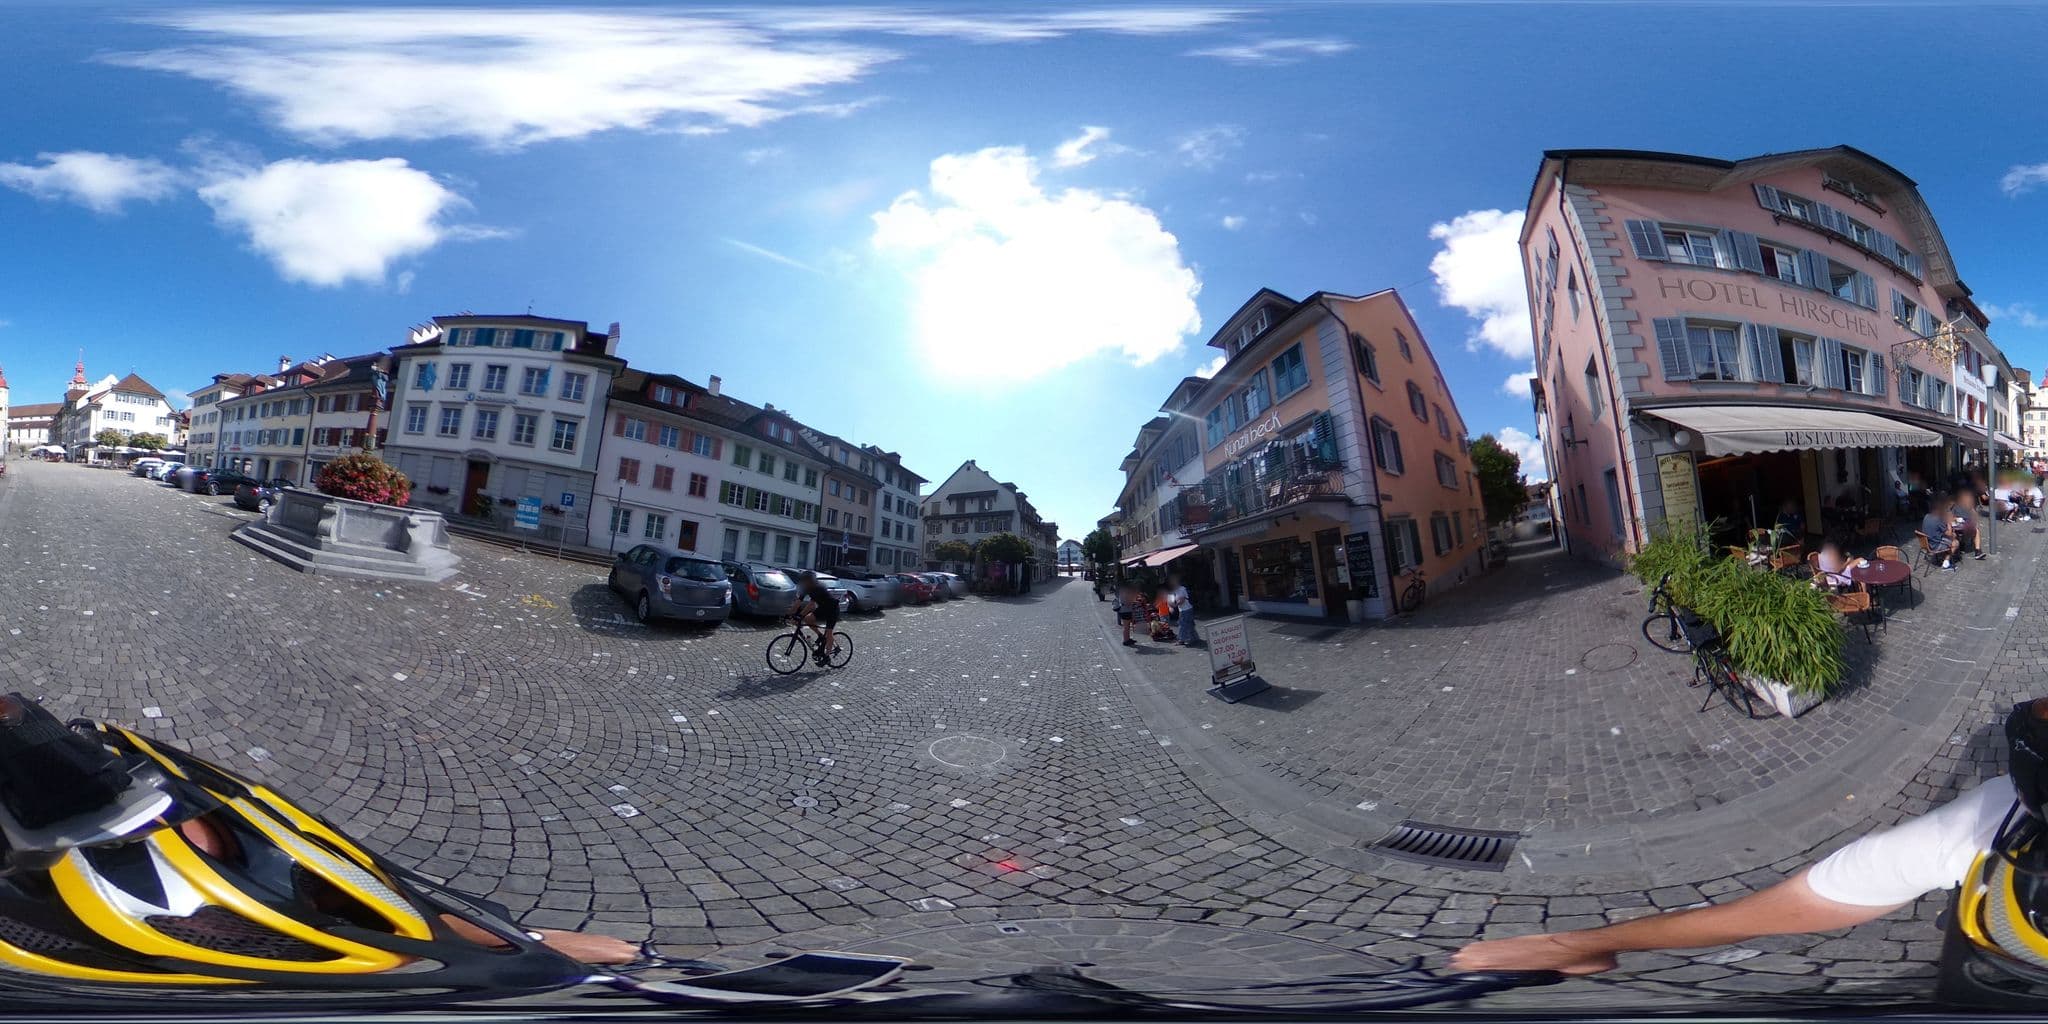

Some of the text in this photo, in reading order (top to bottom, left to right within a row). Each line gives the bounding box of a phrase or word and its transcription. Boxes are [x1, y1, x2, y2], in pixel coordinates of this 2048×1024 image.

[1658, 277, 1878, 339] HOTEL HIRSCHEN
[1785, 431, 1868, 446] RESTAURANT
[1873, 432, 1892, 446] NON
[564, 495, 572, 505] P
[1214, 644, 1234, 654] 07.00
